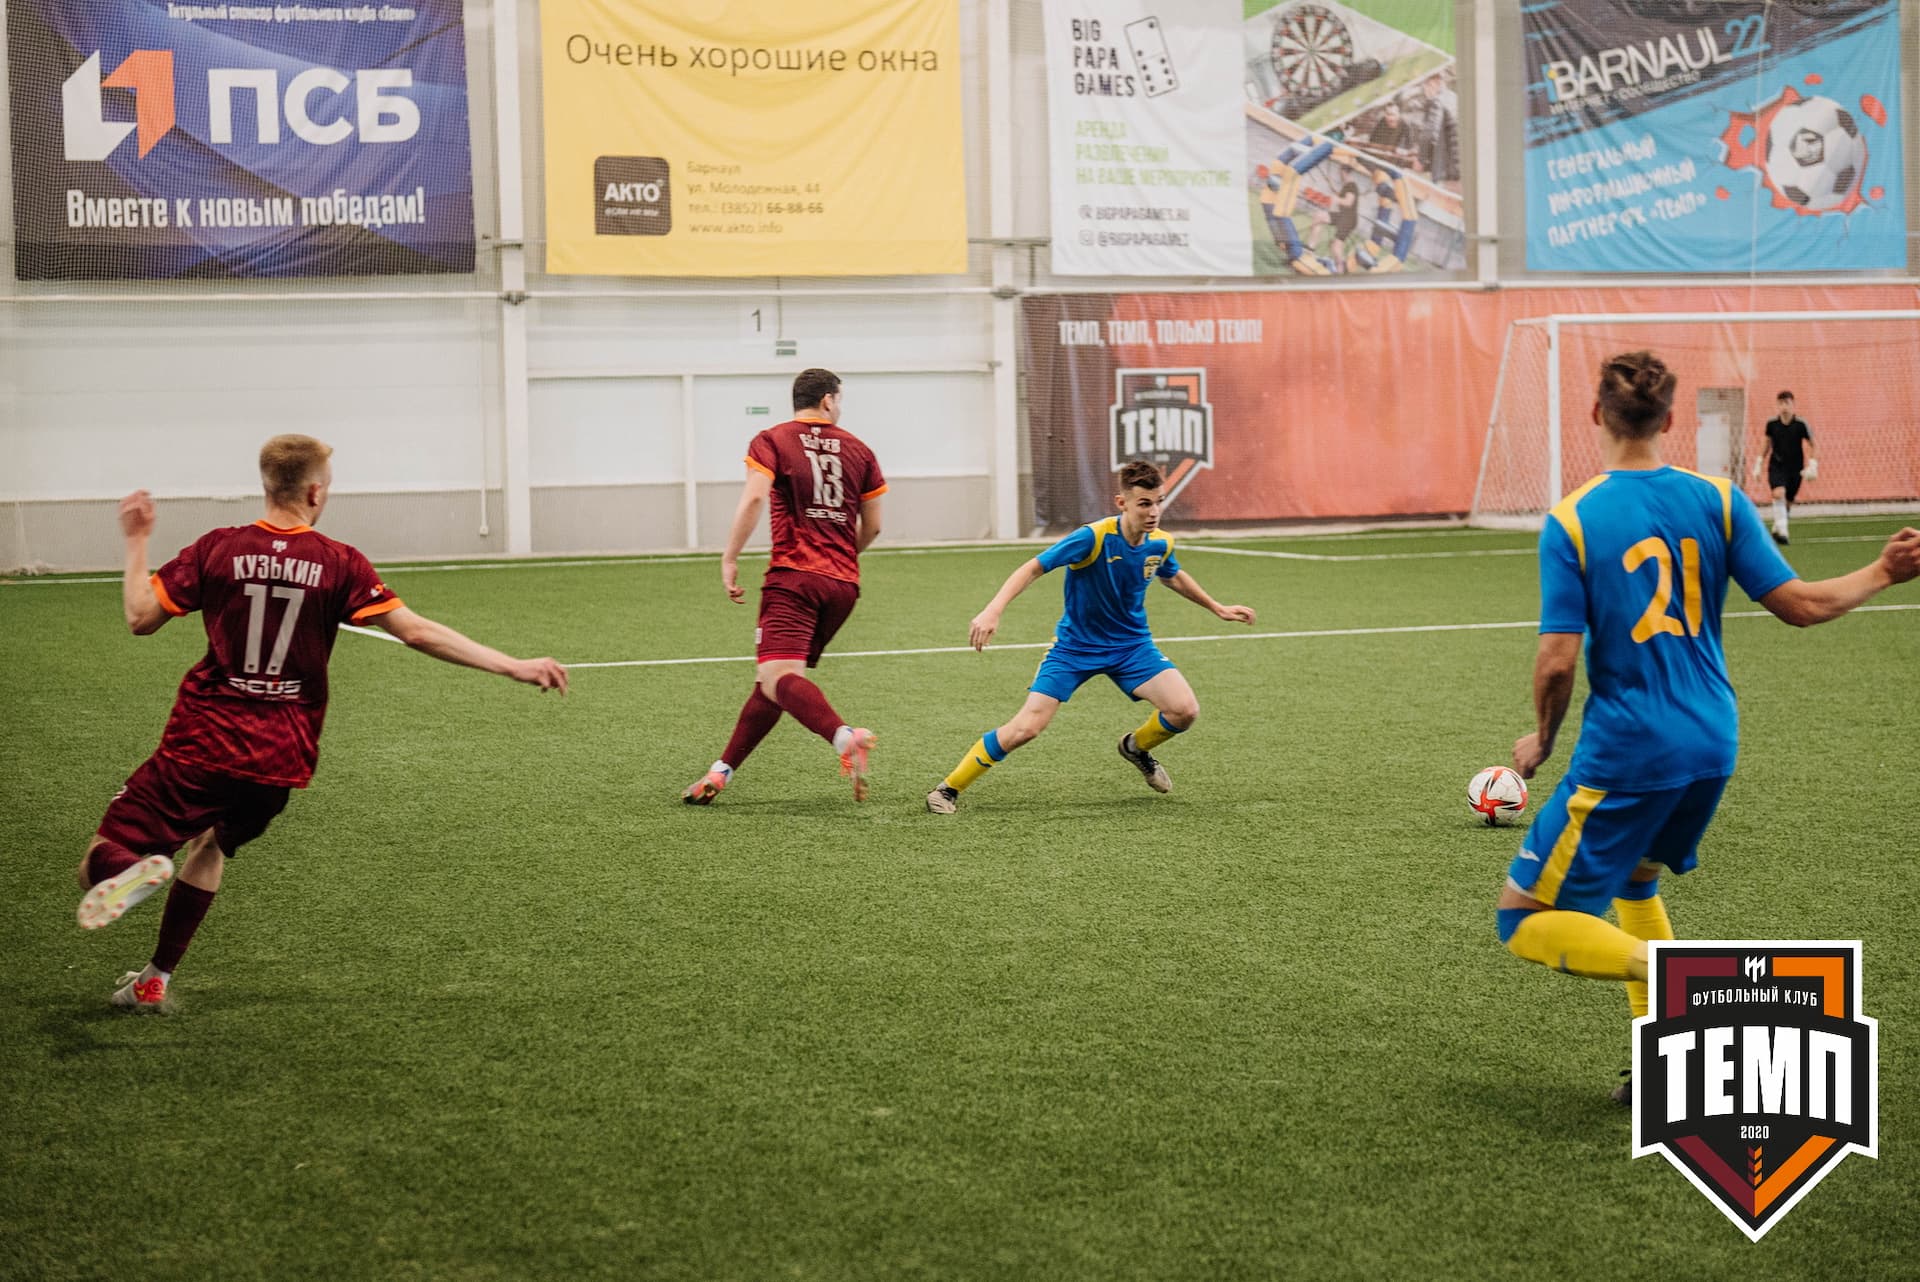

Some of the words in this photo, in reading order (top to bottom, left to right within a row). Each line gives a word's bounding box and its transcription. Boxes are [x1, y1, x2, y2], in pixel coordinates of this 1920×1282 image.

[1072, 19, 1101, 42] BIG
[566, 33, 678, 67] Очень
[690, 42, 847, 76] хорошие
[857, 47, 938, 72] окна
[1074, 47, 1118, 70] PAPA
[1074, 73, 1135, 97] GAMES
[208, 68, 421, 145] ПСБ
[804, 183, 820, 193] 44
[67, 189, 168, 228] Вместе
[177, 198, 193, 227] к
[200, 196, 293, 227] новым
[302, 187, 425, 229] победам!
[766, 203, 824, 214] 66-88-66
[751, 309, 761, 332] 1
[1058, 320, 1106, 347] ТЕМП,
[1107, 320, 1154, 347] ТЕМП,
[1156, 319, 1214, 344] ТОЛЬКО
[1218, 319, 1263, 344] ТЕМП!
[1121, 407, 1205, 456] ТЕМП
[804, 450, 845, 508] 13
[233, 554, 323, 587] КУЗЬКИН
[1622, 536, 1702, 644] 21
[243, 583, 305, 675] 17
